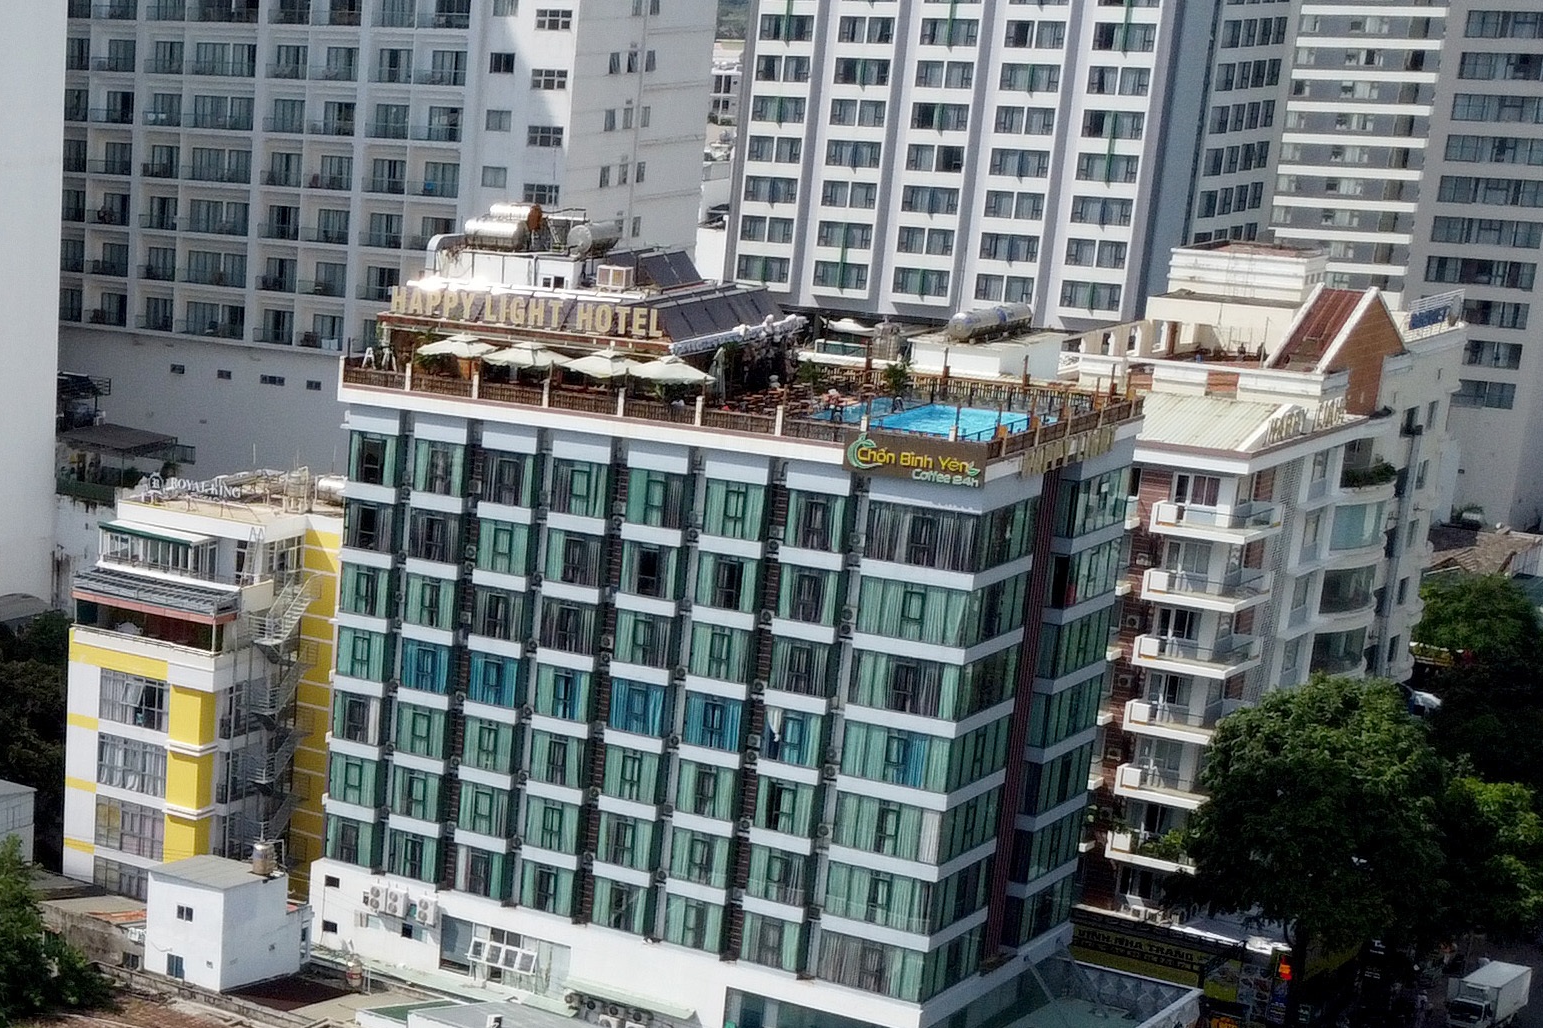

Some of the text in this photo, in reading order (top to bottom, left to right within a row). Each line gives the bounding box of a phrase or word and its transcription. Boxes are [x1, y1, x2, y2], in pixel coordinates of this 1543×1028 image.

[390, 285, 664, 338] HAPPY LIGHT HOTEL
[938, 456, 969, 473] Yên
[911, 468, 951, 484] Coffee
